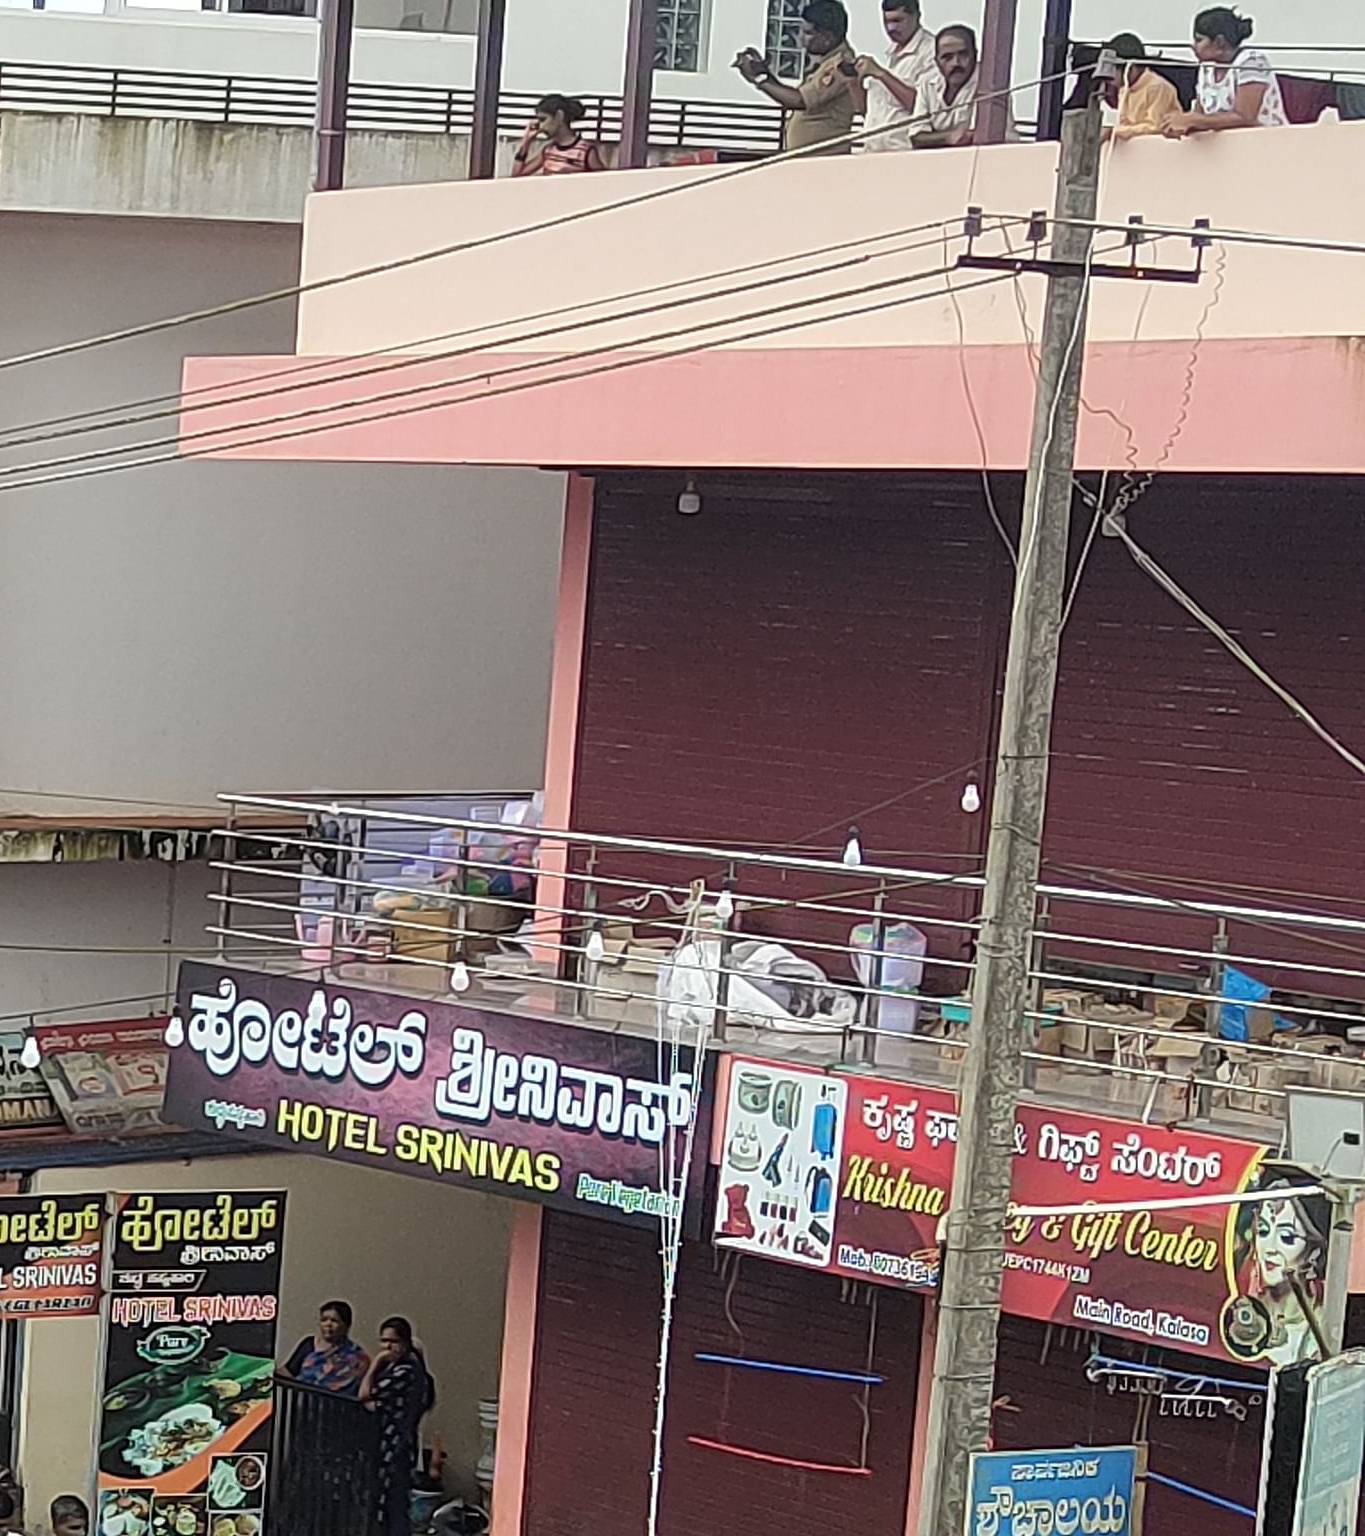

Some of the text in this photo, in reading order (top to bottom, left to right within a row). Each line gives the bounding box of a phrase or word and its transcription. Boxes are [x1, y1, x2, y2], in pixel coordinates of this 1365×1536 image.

[188, 977, 693, 1143] ಹೋಟೆಲ್ ಶ್ರೀನಿವಾಸ್
[276, 1098, 388, 1155] HOTEL
[395, 1122, 560, 1191] SRINIVAS
[862, 1095, 918, 1151] ಕೃಷ್ಣ
[1037, 1122, 1101, 1182] ಗಿಫ್ಟ್
[1111, 1130, 1223, 1187] ಸೆಂಟರ್
[121, 1195, 277, 1252] ಹೋಟೆಲ್
[842, 1154, 945, 1217] Krishna
[1069, 1202, 1120, 1254] Gift
[1124, 1215, 1220, 1272] Center
[13, 1263, 97, 1289] SRINIVAS
[112, 1294, 276, 1328] HOTEL SRINIVAS
[1074, 1295, 1111, 1326] Main
[1112, 1302, 1155, 1332] Road,
